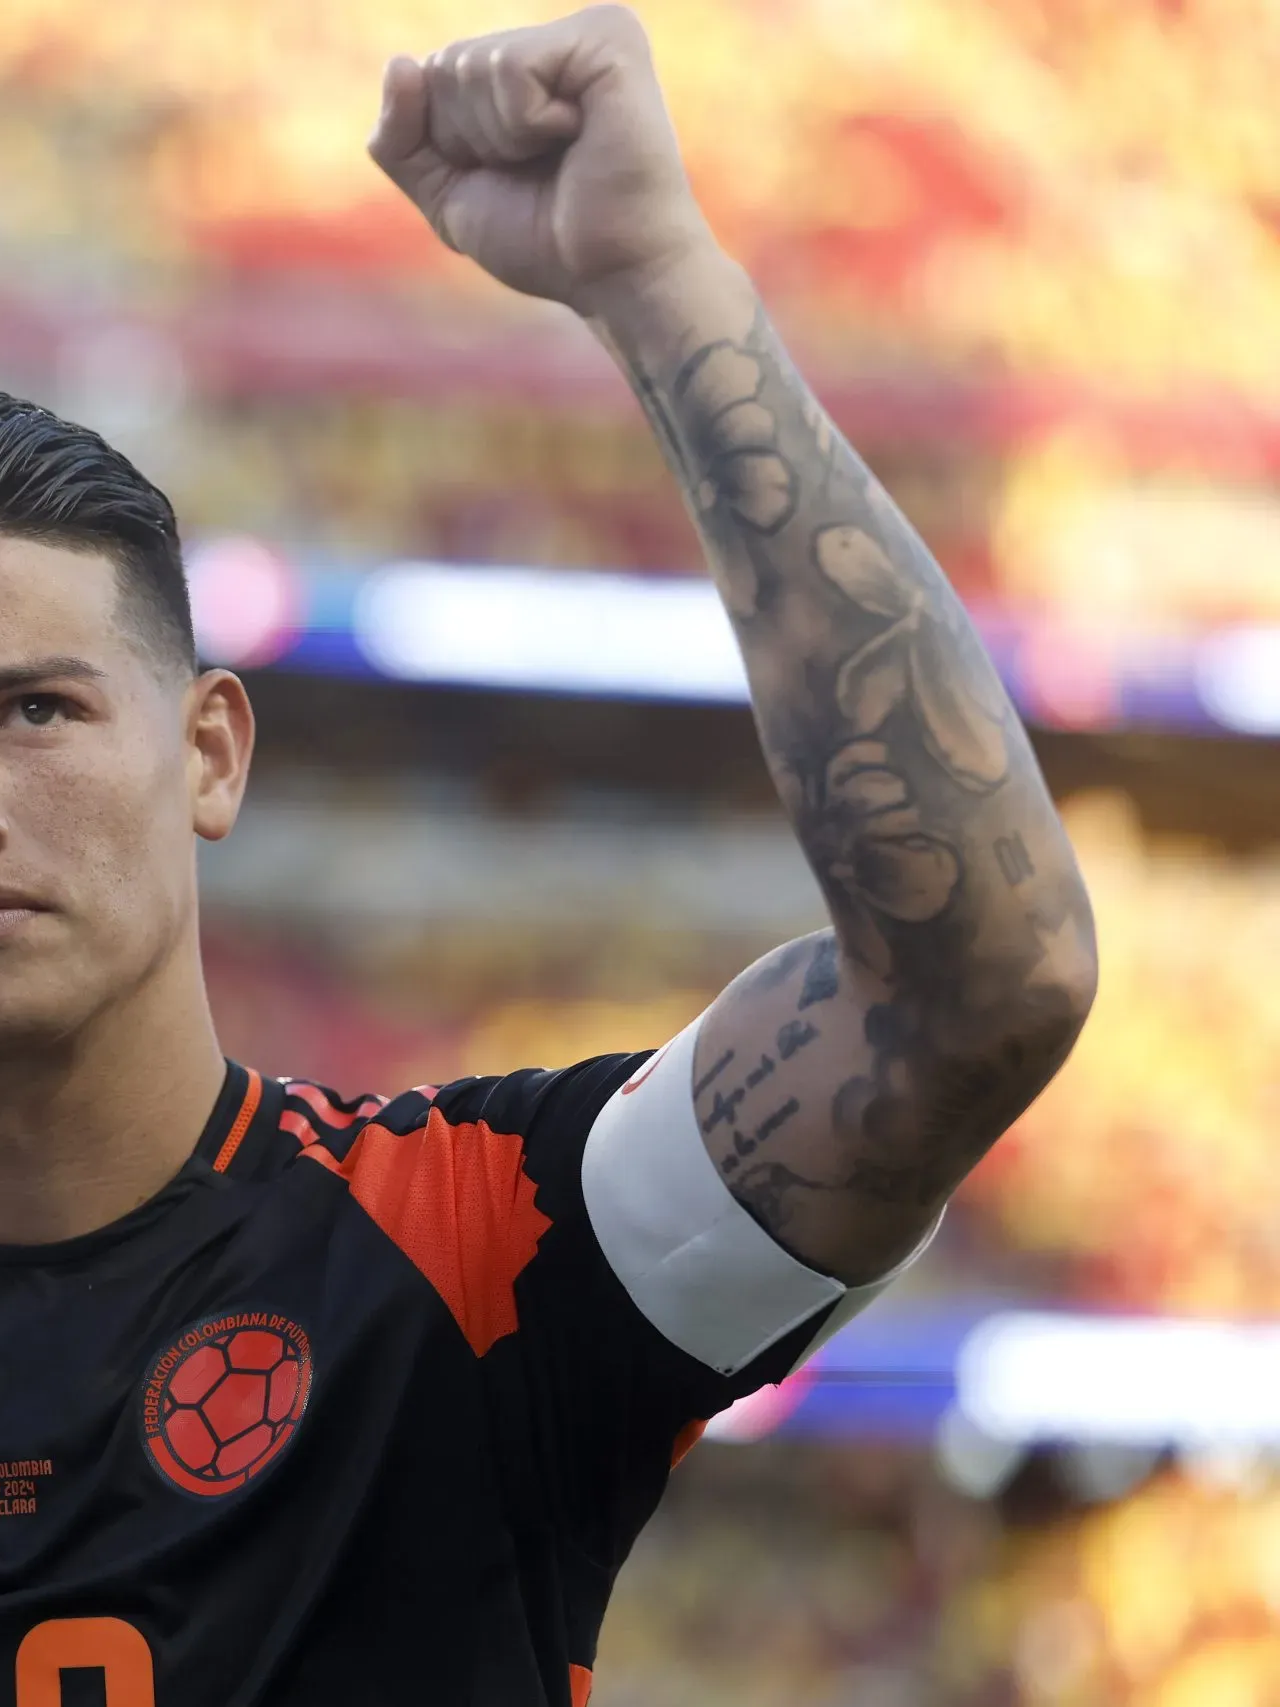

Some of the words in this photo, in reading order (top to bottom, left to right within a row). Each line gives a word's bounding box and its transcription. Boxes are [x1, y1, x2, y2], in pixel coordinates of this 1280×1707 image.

[144, 1345, 181, 1433] FEDERACIÓN
[178, 1313, 268, 1351] COLOMBIANA
[268, 1314, 287, 1331] DE
[4, 1480, 36, 1496] 2024
